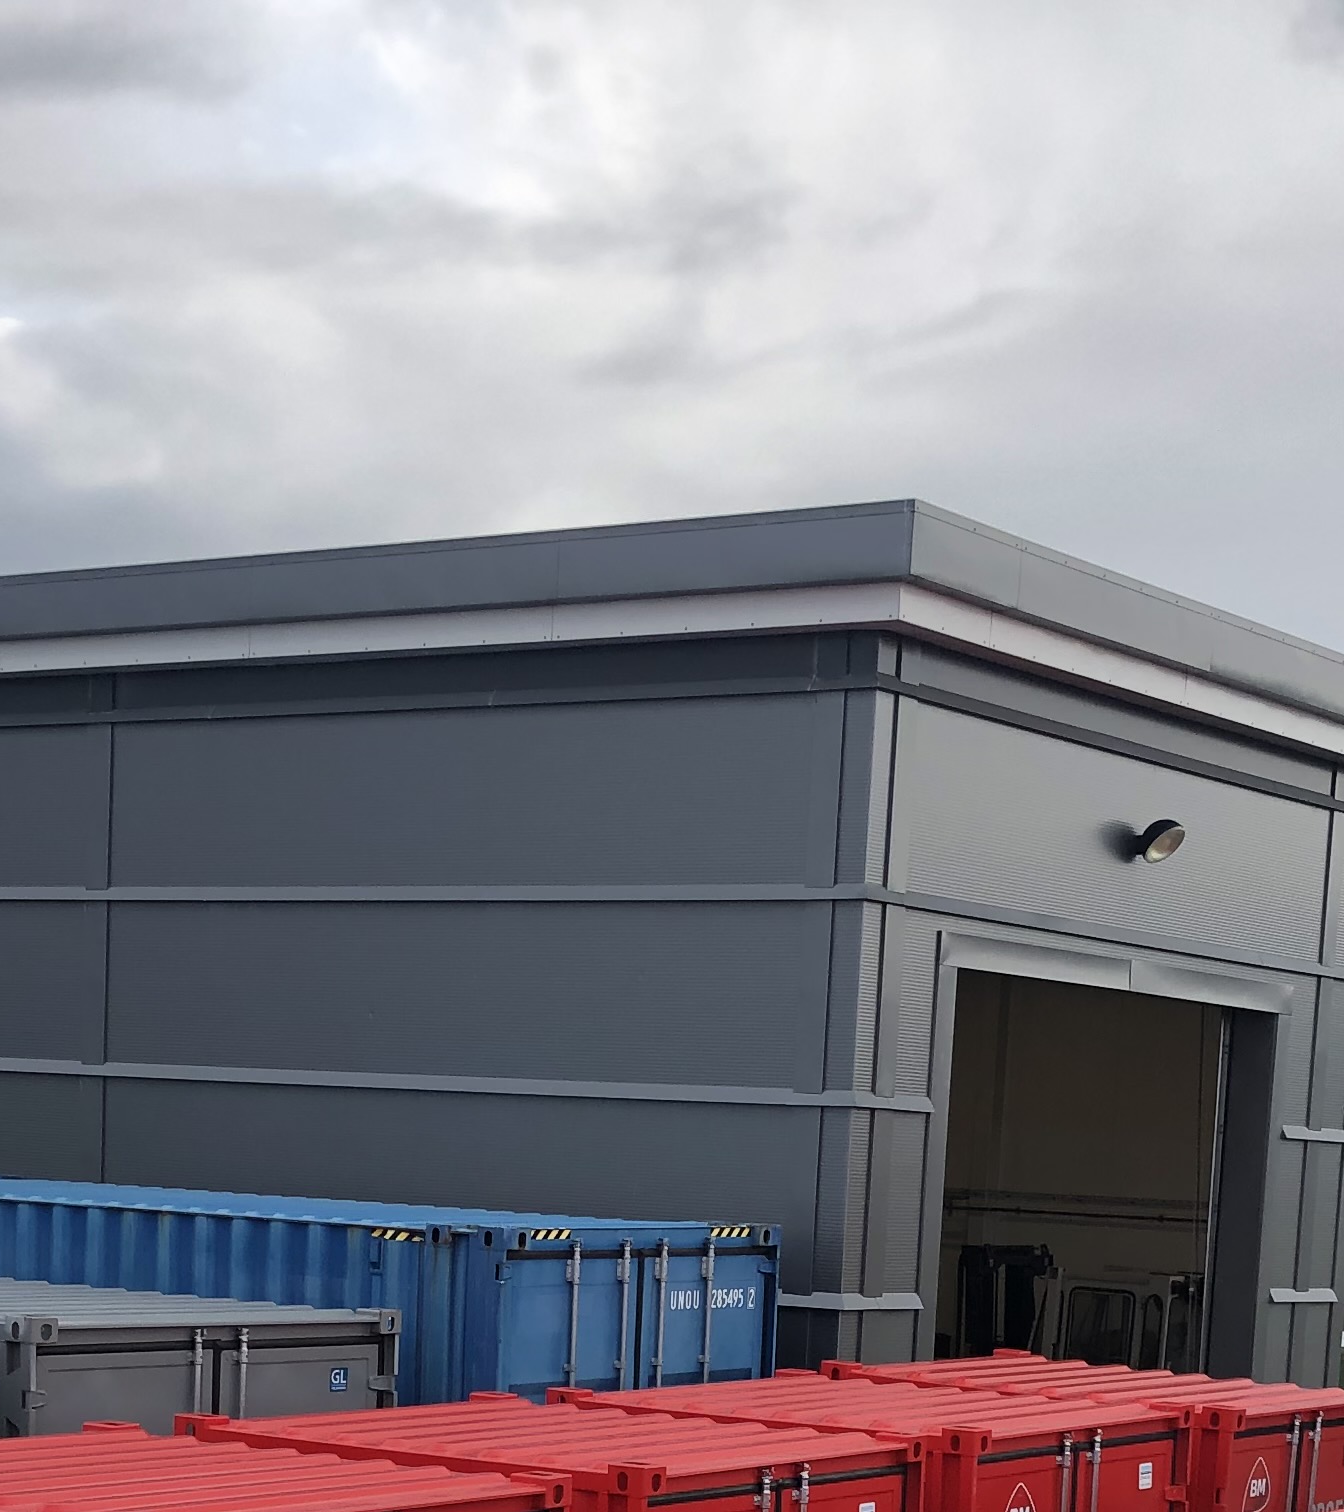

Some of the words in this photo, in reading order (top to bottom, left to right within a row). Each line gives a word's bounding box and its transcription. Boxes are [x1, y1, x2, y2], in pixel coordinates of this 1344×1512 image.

[670, 1290, 700, 1311] UNOU
[710, 1288, 744, 1309] 285495
[331, 1369, 347, 1384] GL
[1249, 1478, 1267, 1498] BM
